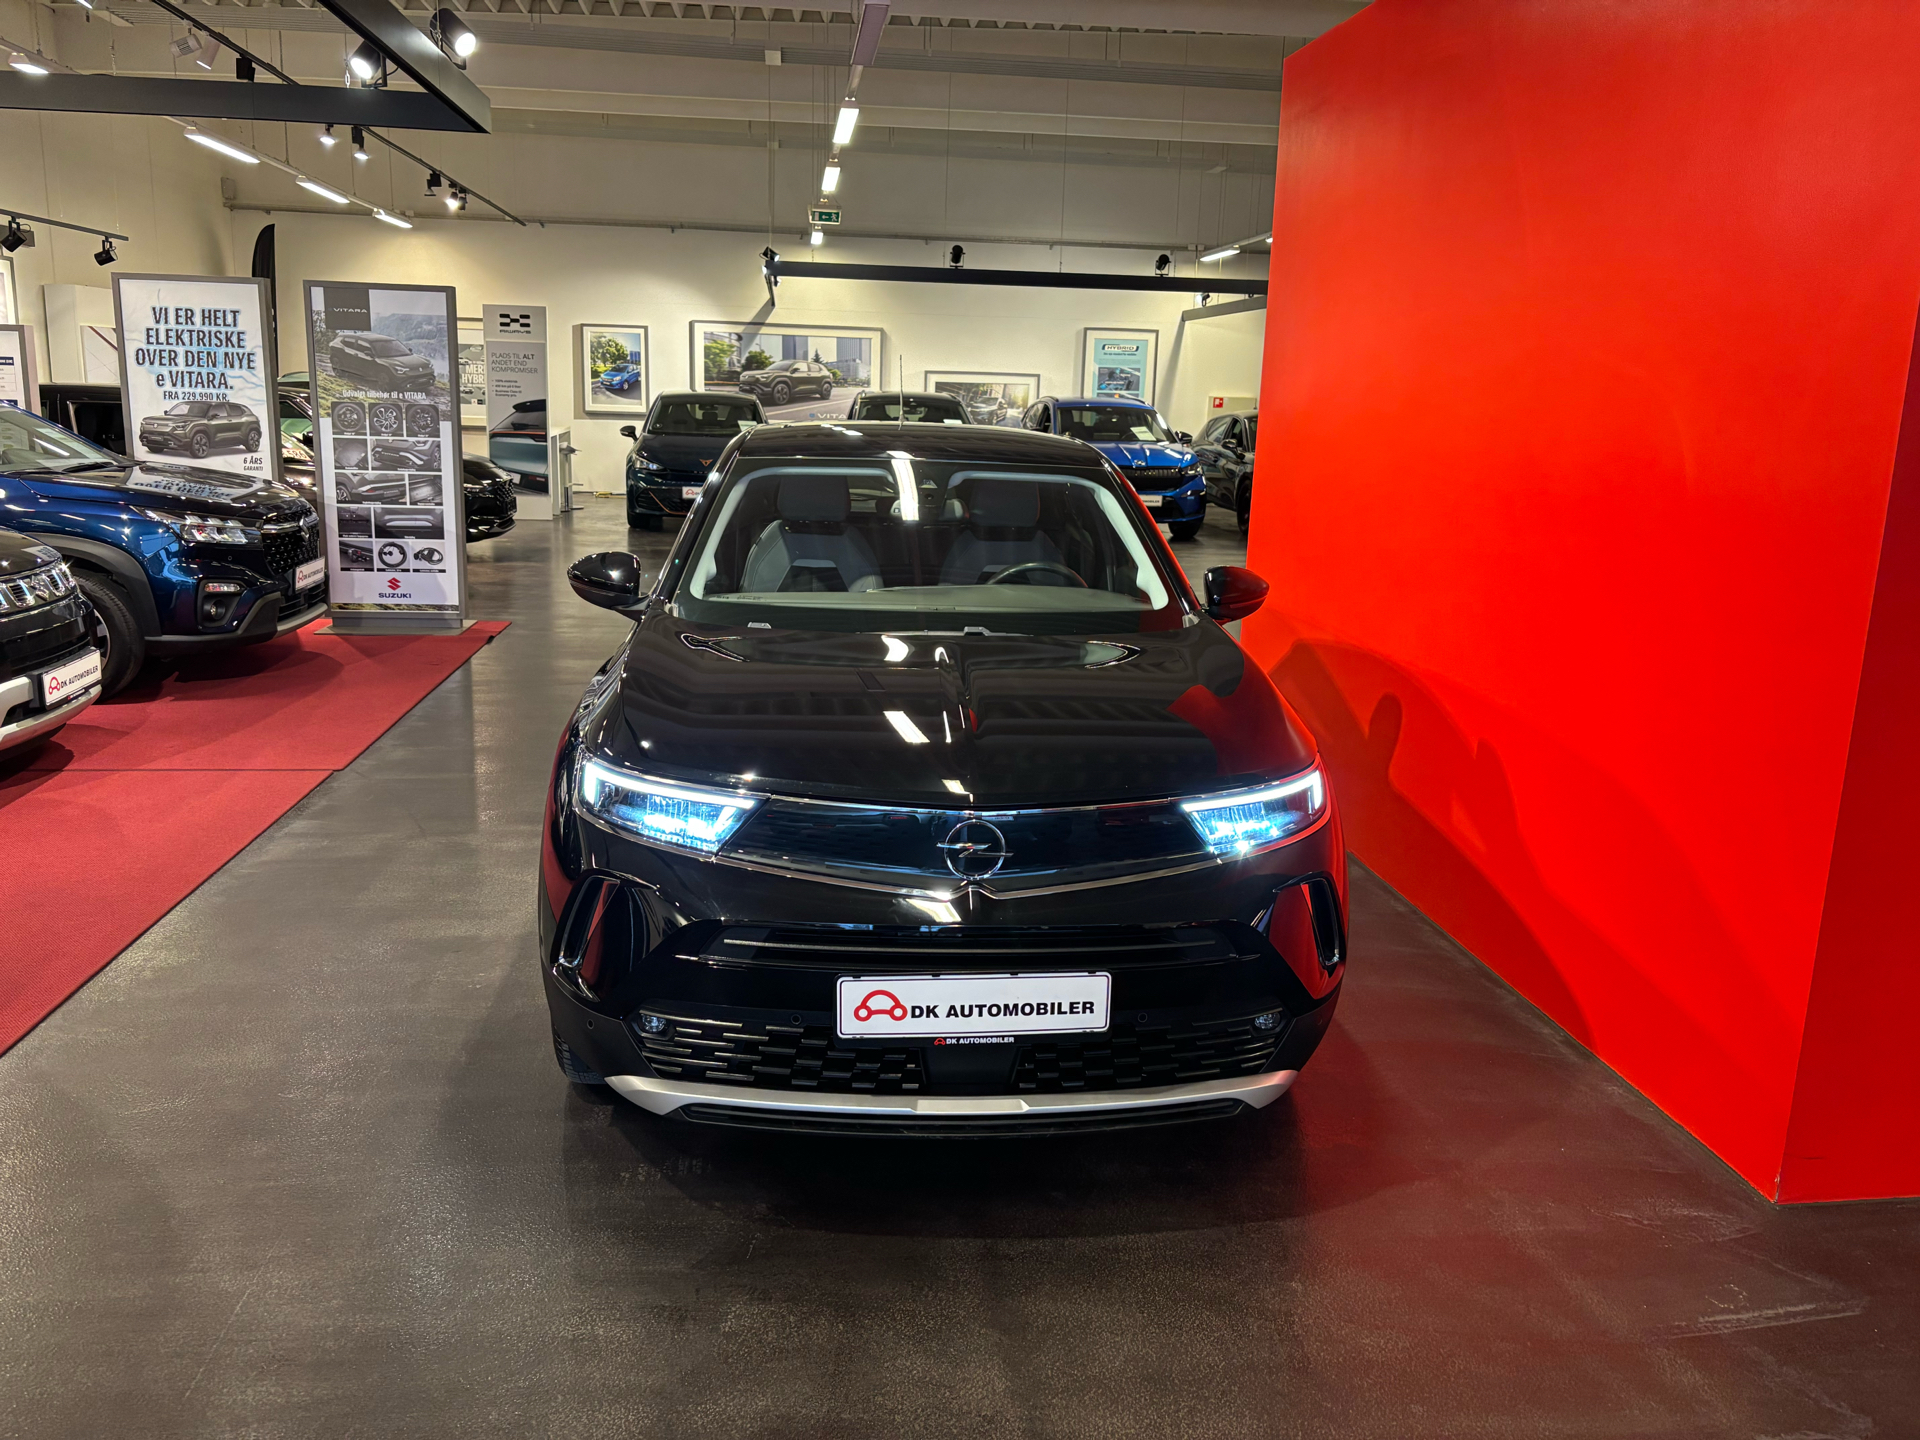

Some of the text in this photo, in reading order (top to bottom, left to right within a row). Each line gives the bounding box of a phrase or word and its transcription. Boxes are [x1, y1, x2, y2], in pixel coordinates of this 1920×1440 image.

[152, 306, 239, 327] VI ER HELT
[146, 328, 245, 348] ELEKTRISKE
[135, 348, 255, 370] OVER DEN NYE
[466, 365, 485, 373] MER
[156, 370, 233, 389] e VITARA.
[462, 374, 485, 383] HYBR
[164, 391, 230, 402] FRA 229.990 KR.
[249, 455, 262, 465] ÅRS
[69, 665, 98, 684] AUTOMOBILER
[911, 1001, 1095, 1019] DK AUTOMOBILER
